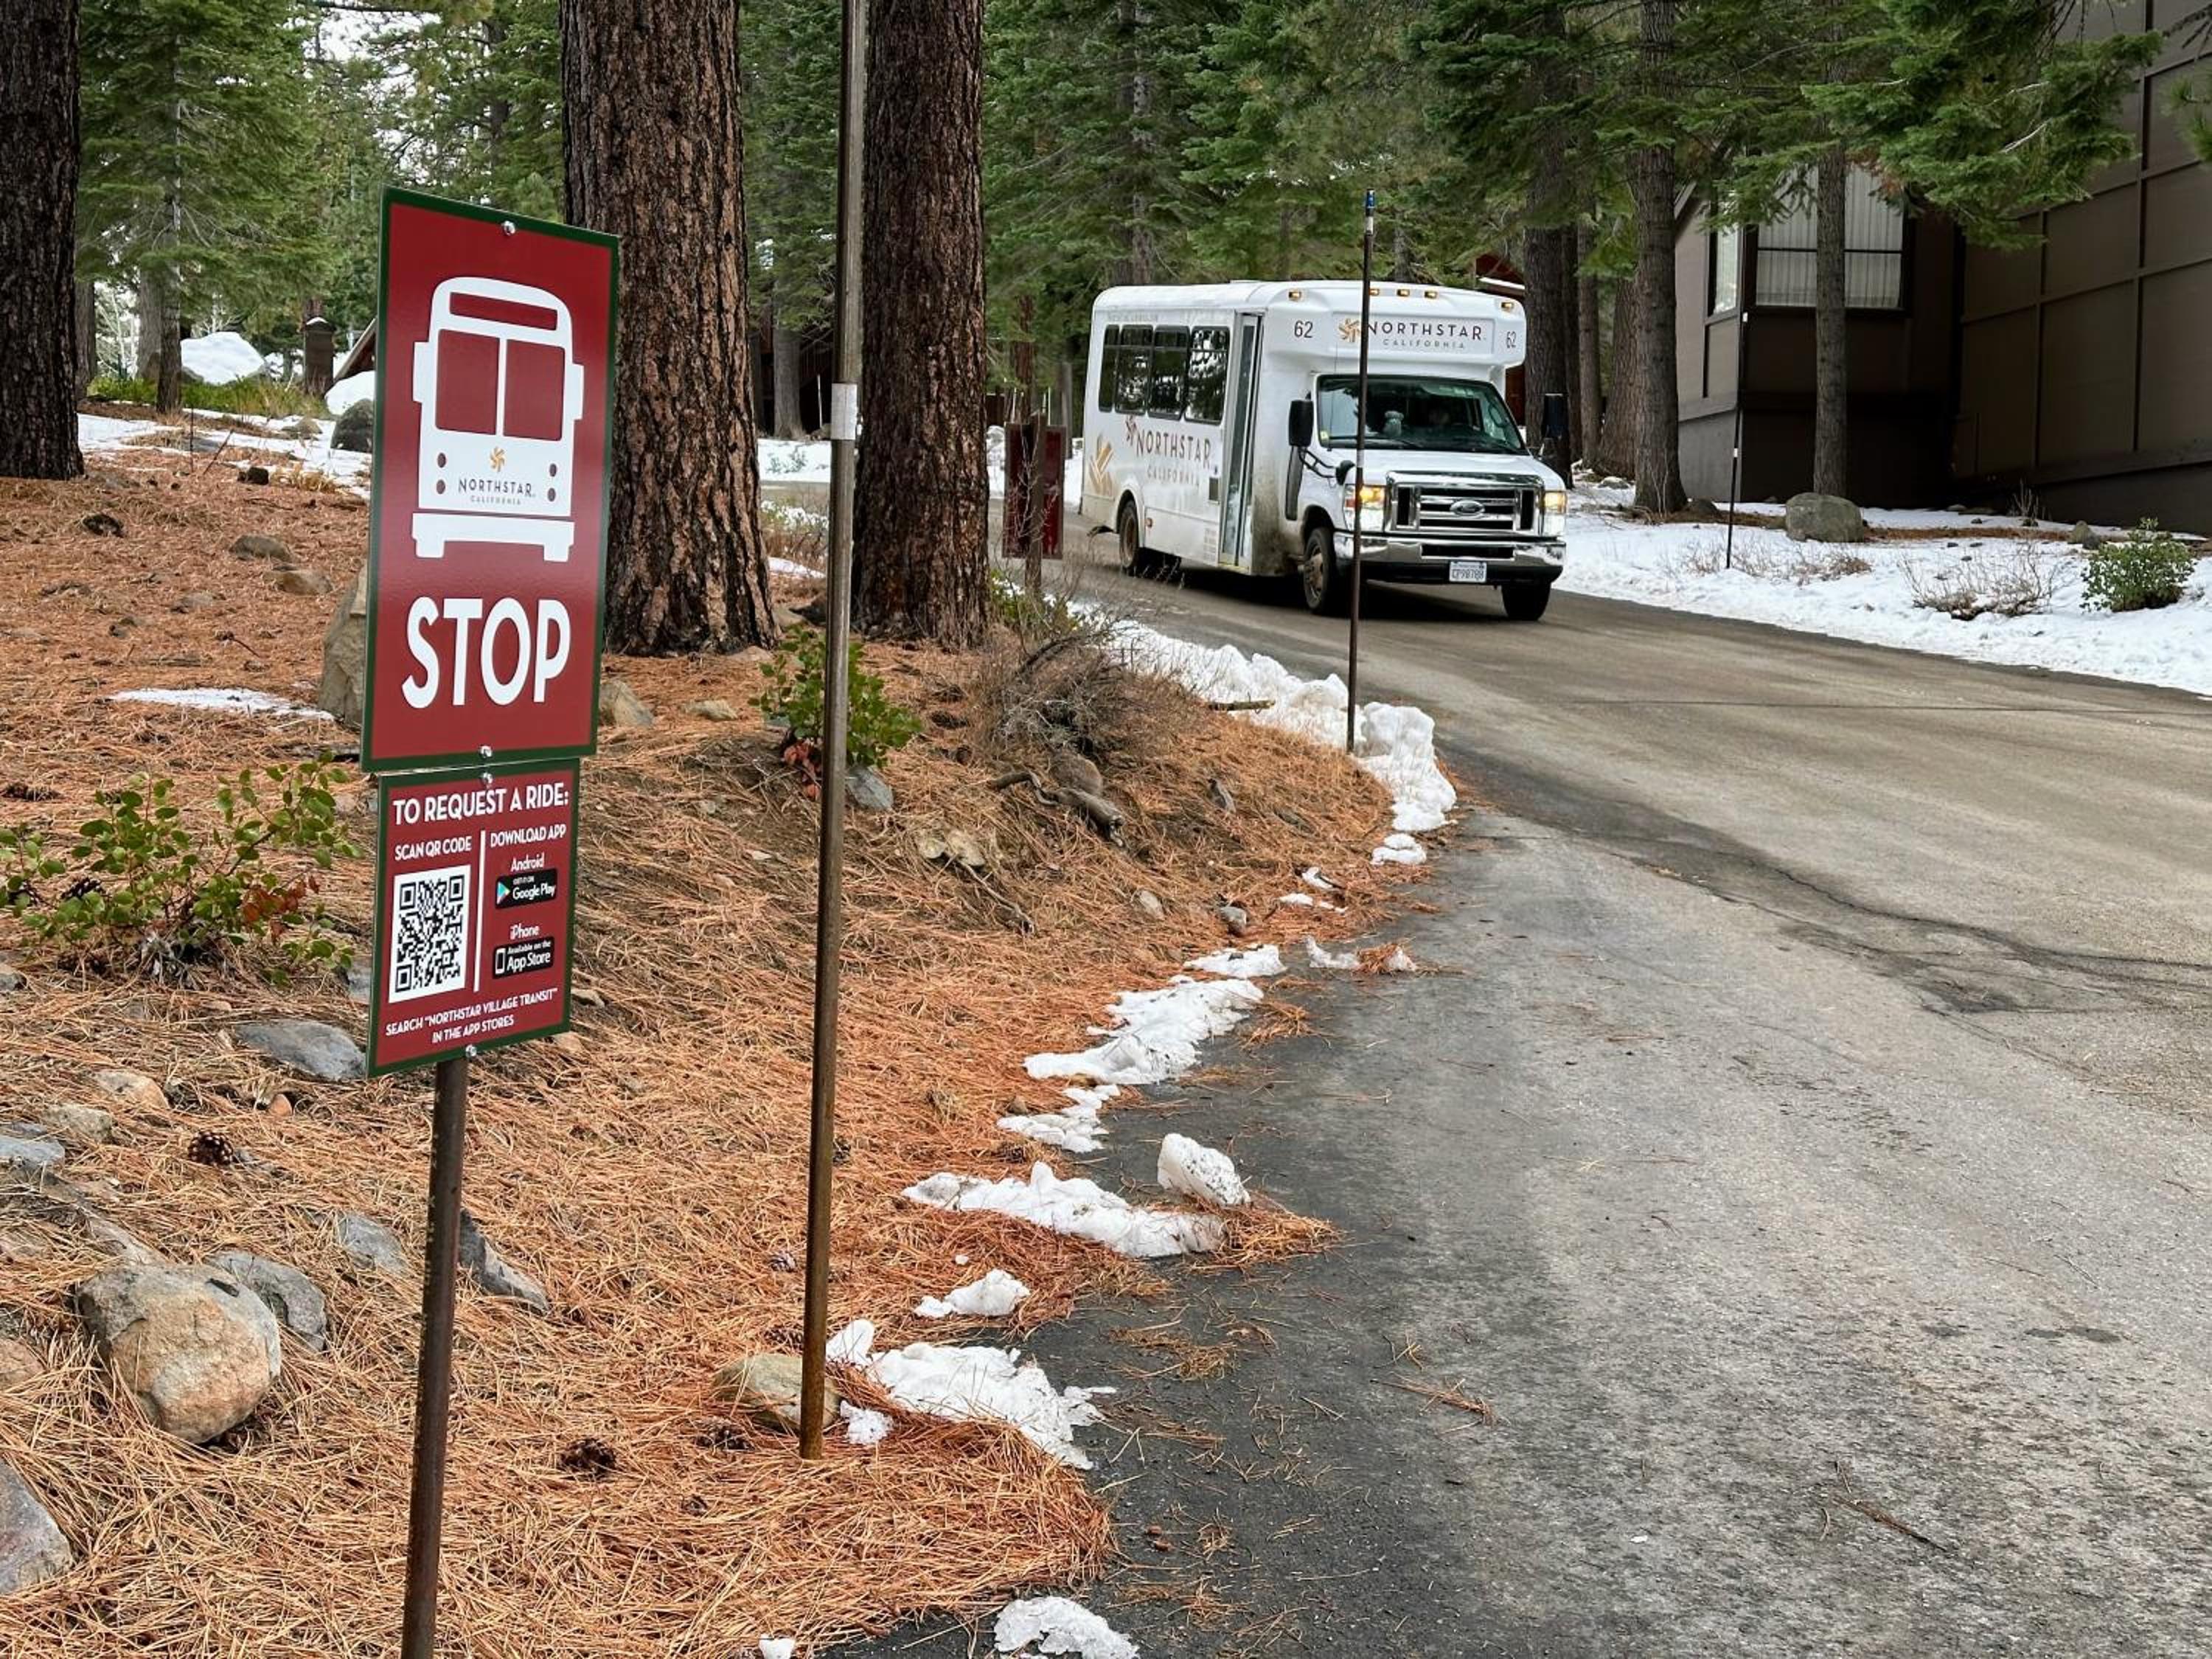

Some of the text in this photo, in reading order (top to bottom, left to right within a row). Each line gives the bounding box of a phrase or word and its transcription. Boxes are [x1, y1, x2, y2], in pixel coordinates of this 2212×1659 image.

[1294, 320, 1313, 339] 62
[1368, 321, 1483, 341] NORTHSTAR
[1506, 330, 1517, 349] 62
[1382, 339, 1465, 349] CALIFORNIA
[1135, 429, 1211, 469] NORTHSTAR
[458, 478, 532, 498] NORTHSTAR
[402, 597, 571, 709] STOP
[393, 782, 569, 825] TO REQUEST A RIDE:
[490, 824, 566, 847] DOWNLOAD APP
[394, 836, 473, 860] SCAN QR CODE
[510, 852, 545, 872] Android
[512, 883, 556, 900] Google Play
[509, 923, 540, 940] iPhone
[507, 951, 551, 973] App Store
[386, 1019, 424, 1037] SEARCH
[483, 995, 518, 1014] VILLAGE
[431, 1015, 515, 1043] IN THE APP STORES
